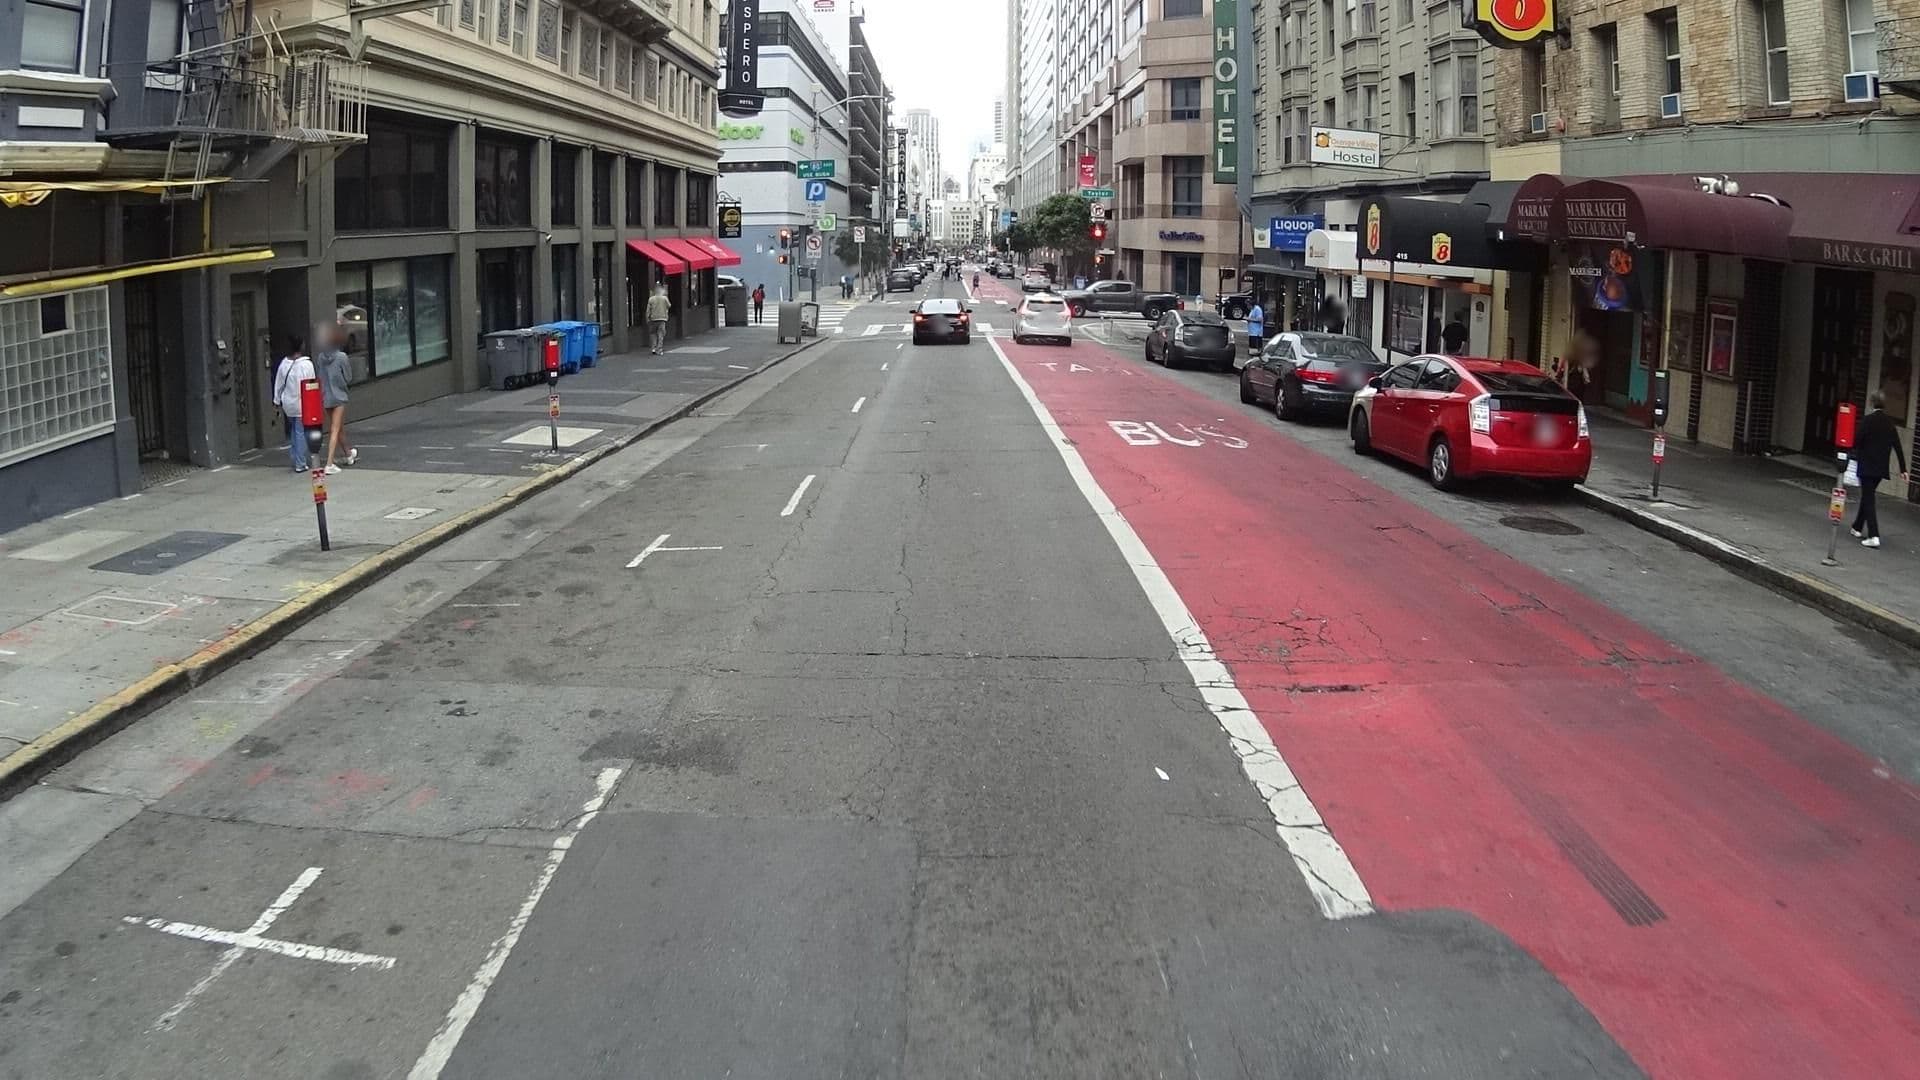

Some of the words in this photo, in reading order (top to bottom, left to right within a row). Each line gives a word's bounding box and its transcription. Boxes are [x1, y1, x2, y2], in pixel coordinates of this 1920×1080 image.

[742, 6, 752, 83] SPERO
[1215, 27, 1238, 172] HOTEL
[1333, 150, 1376, 165] Hostel
[1087, 190, 1109, 198] Taylor
[1565, 202, 1626, 218] MARRAKECH
[1275, 220, 1315, 231] LIQUOR
[1567, 221, 1626, 237] RESTAURANT
[1437, 244, 1449, 260] 8
[1823, 242, 1851, 263] BAR
[1853, 247, 1866, 264] &
[1870, 247, 1912, 269] GRILL
[1106, 420, 1249, 449] BUS
